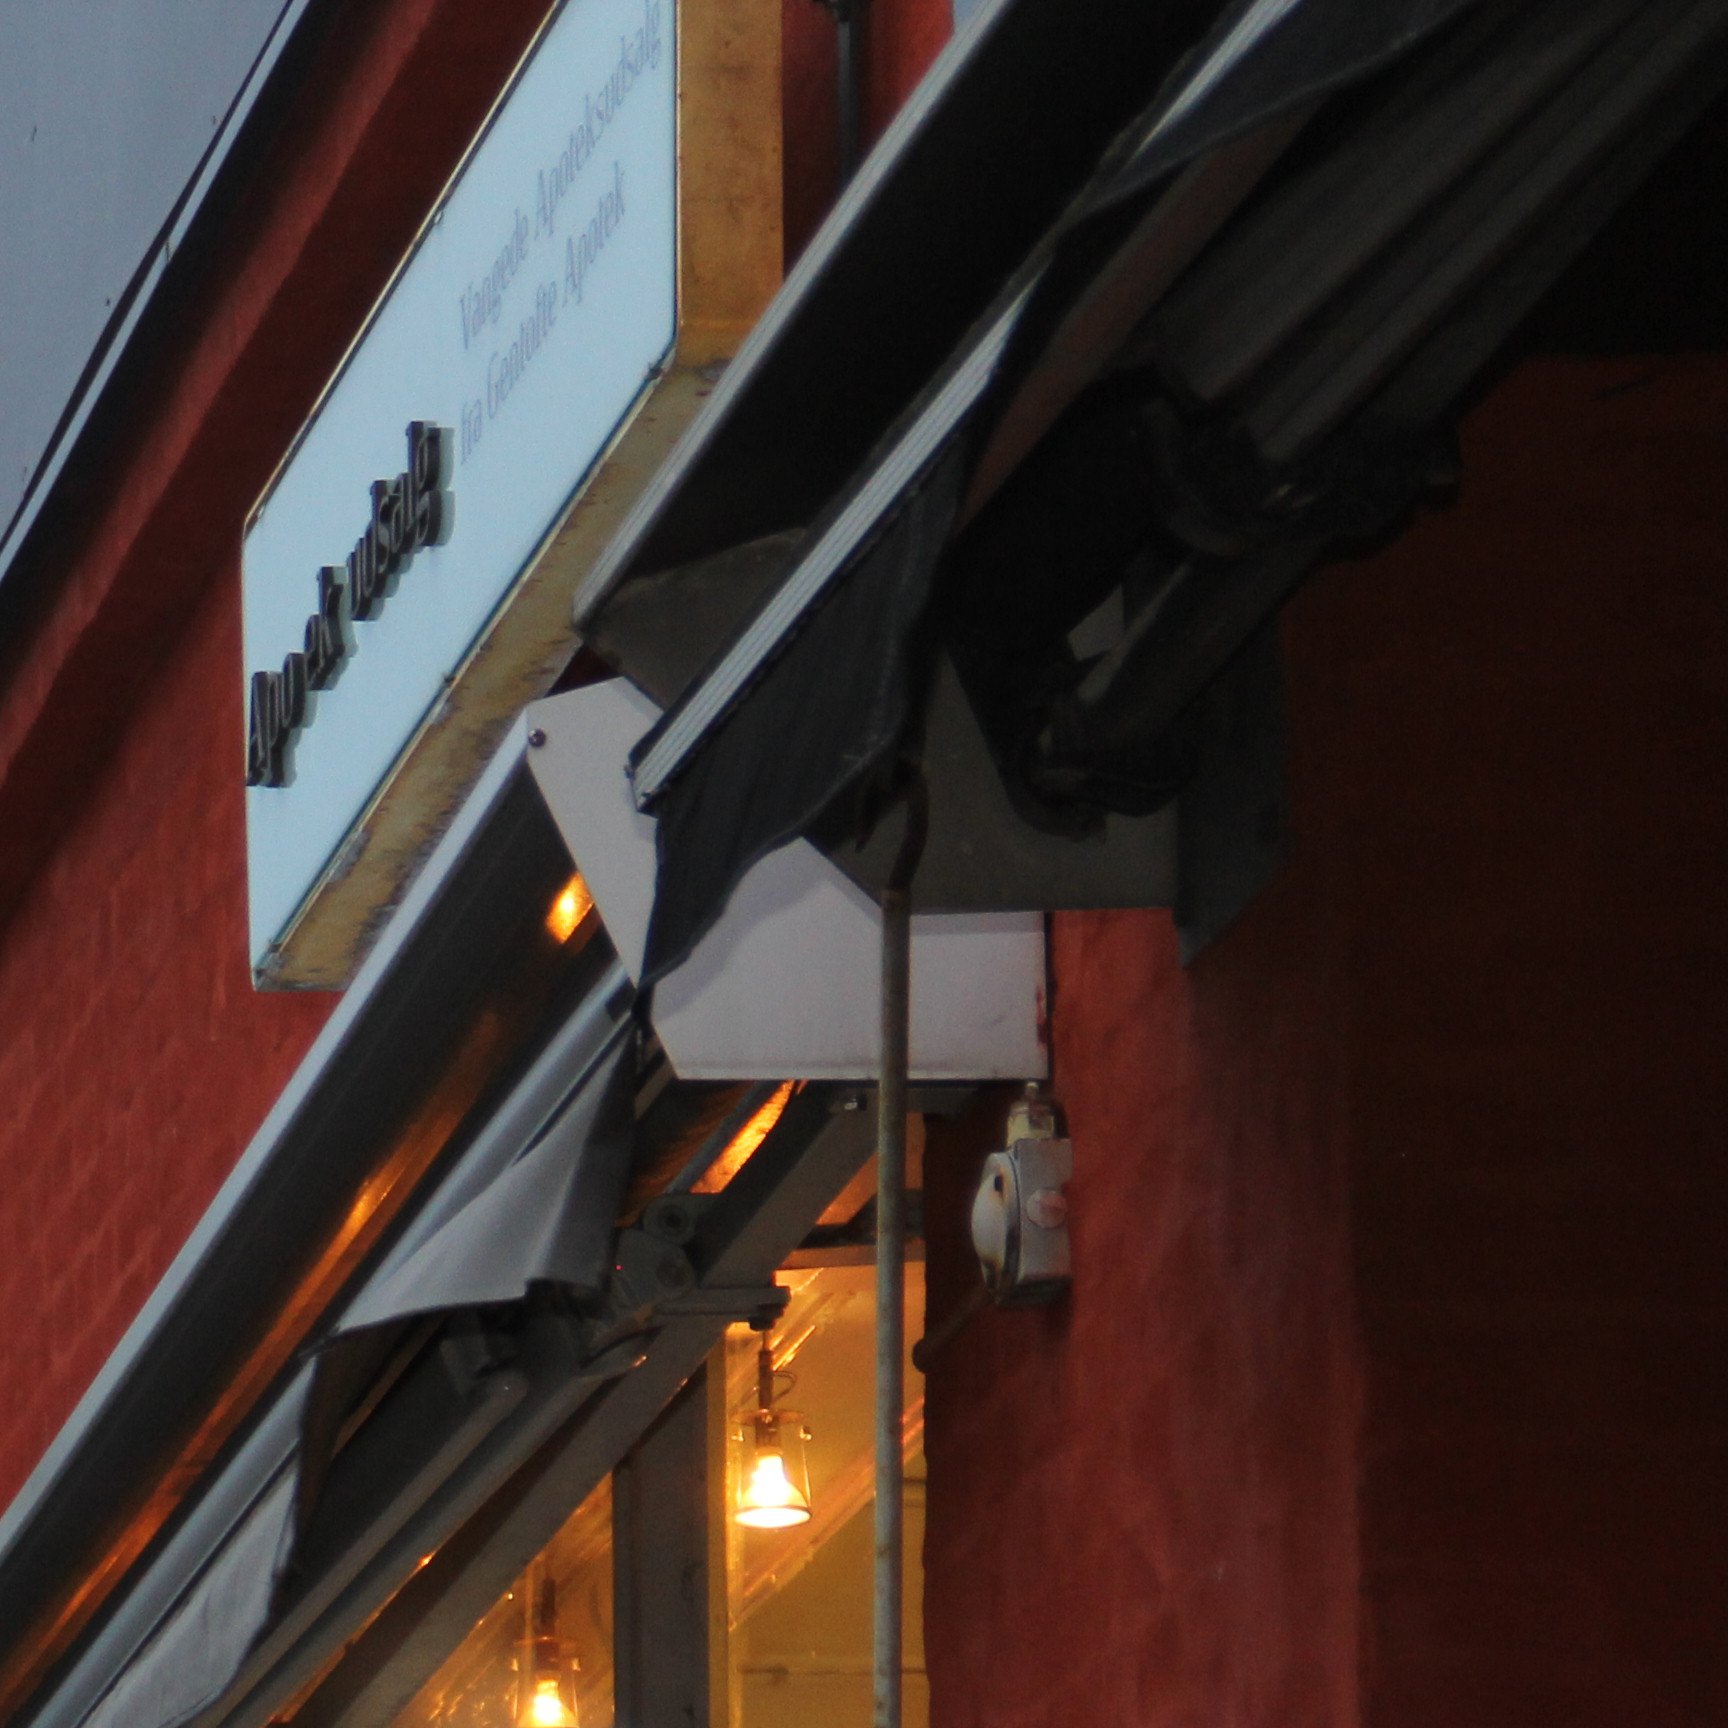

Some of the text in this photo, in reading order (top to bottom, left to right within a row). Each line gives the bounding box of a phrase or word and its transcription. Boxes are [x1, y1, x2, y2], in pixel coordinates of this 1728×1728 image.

[459, 207, 528, 350] Vangede
[461, 160, 626, 465] fra Gentofte Apotek
